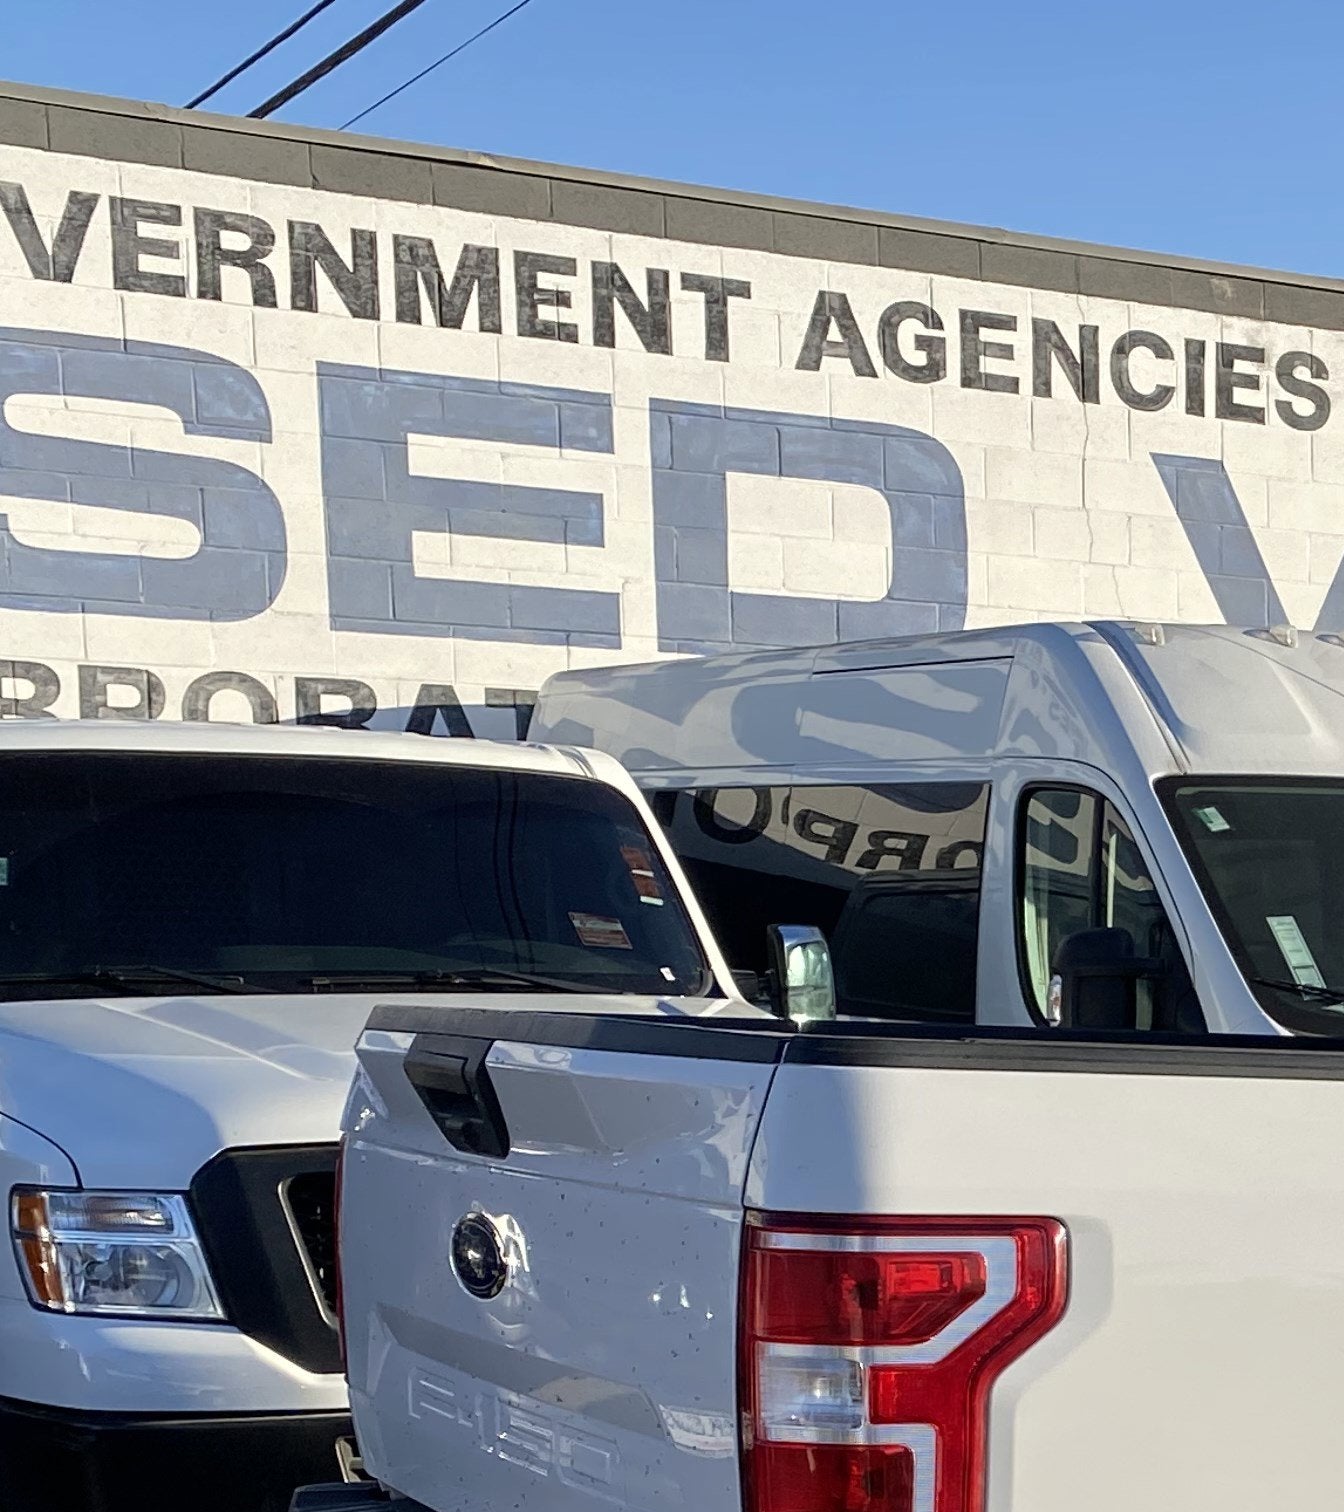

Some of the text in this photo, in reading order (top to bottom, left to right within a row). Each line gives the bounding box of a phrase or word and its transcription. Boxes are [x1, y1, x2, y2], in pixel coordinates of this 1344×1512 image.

[0, 180, 752, 362] VERNMENT
[794, 289, 1332, 432] AGENCIES
[0, 327, 968, 652] SED
